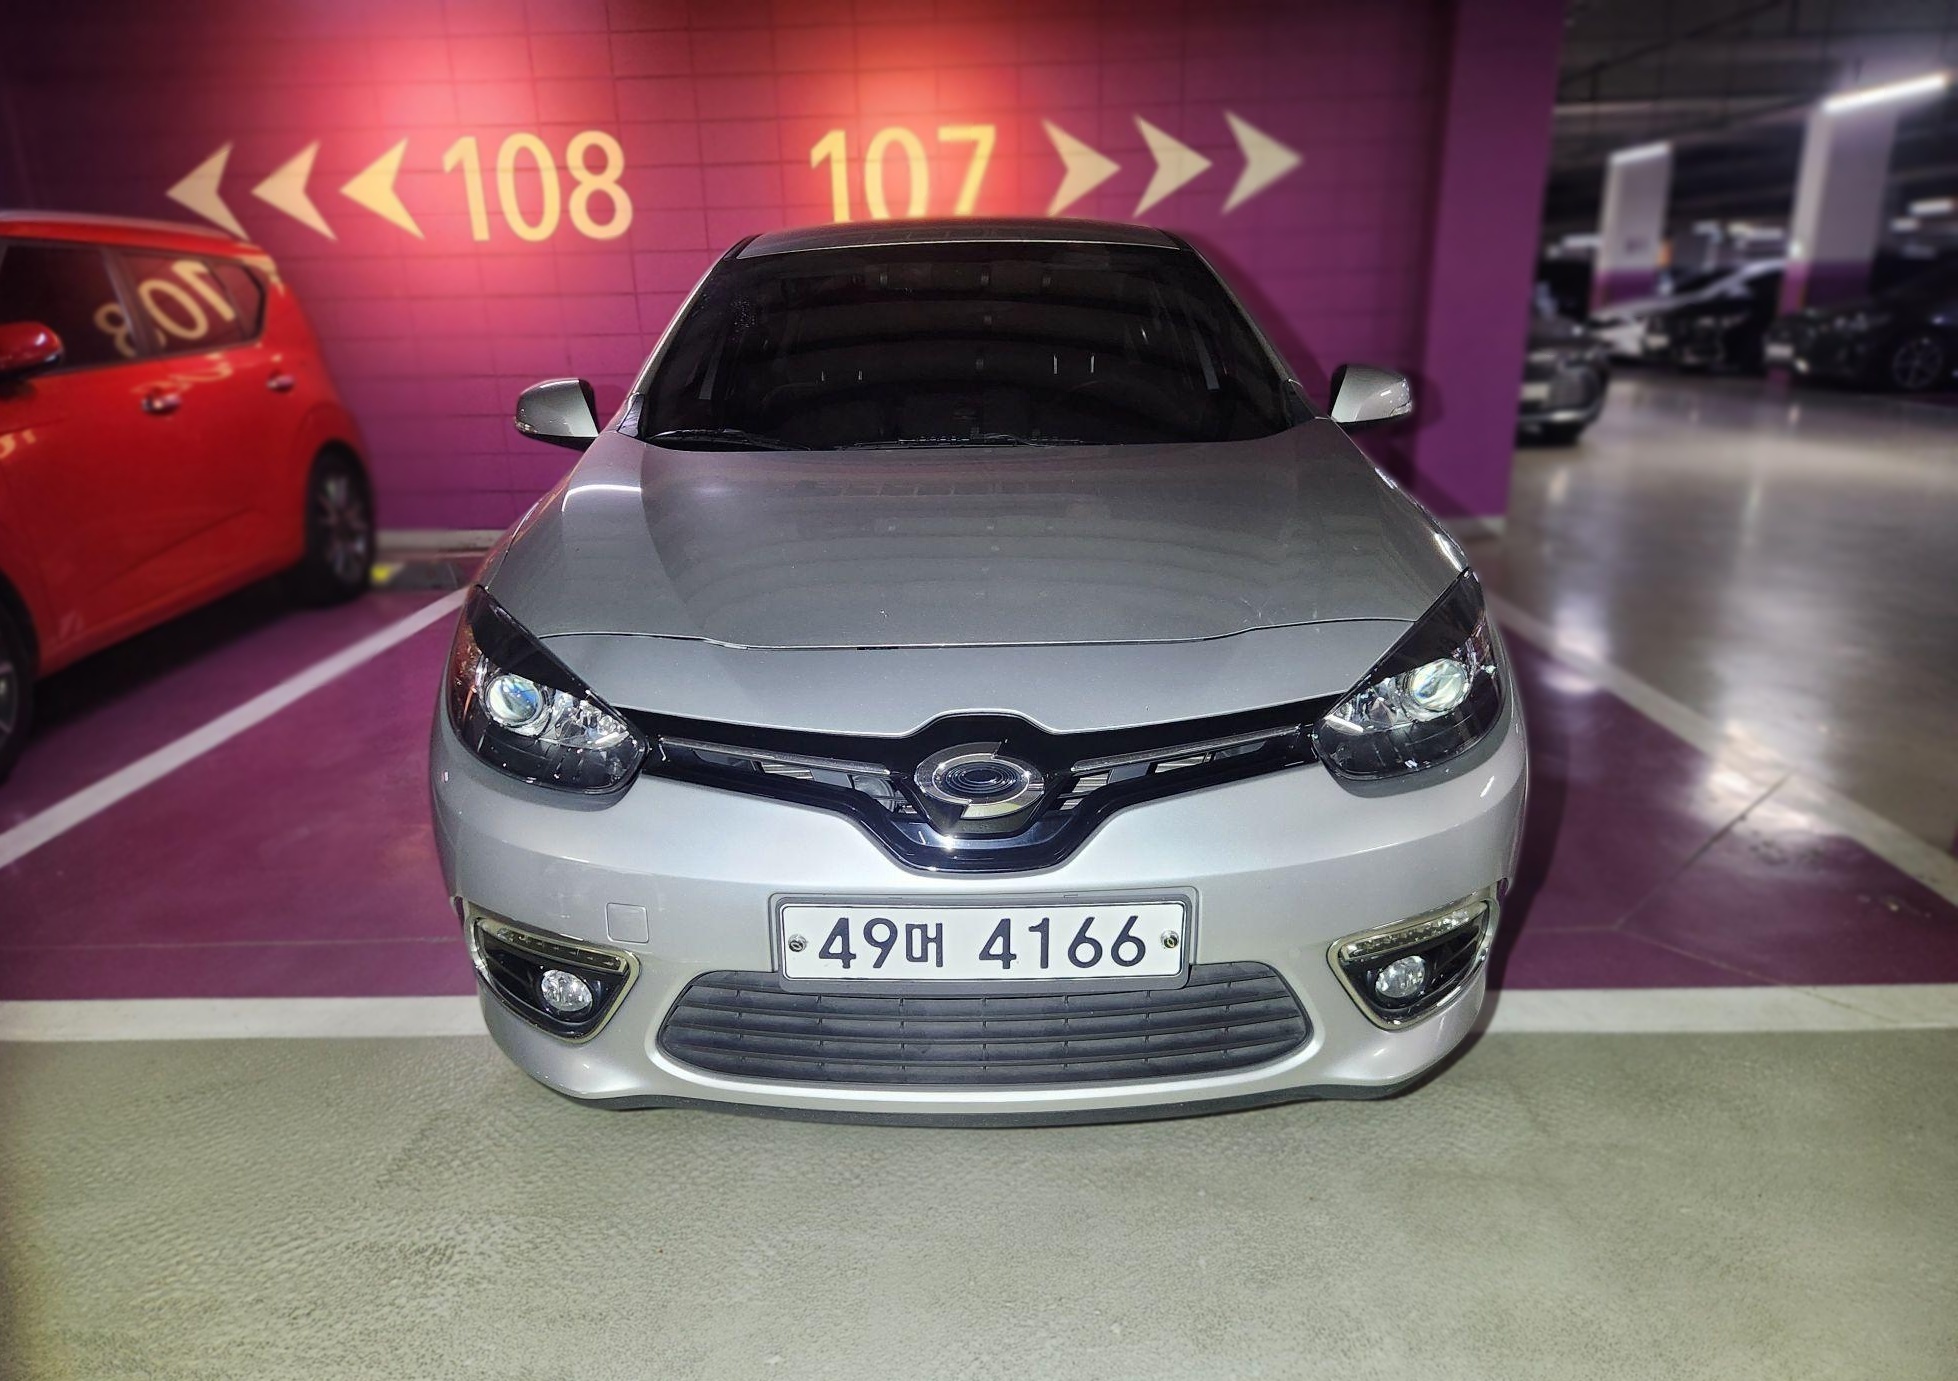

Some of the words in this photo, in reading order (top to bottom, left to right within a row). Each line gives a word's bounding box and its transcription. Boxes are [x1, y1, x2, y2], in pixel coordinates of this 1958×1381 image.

[442, 129, 634, 243] 108
[810, 124, 997, 223] 107
[818, 917, 943, 969] 49머
[978, 915, 1147, 970] 4166
